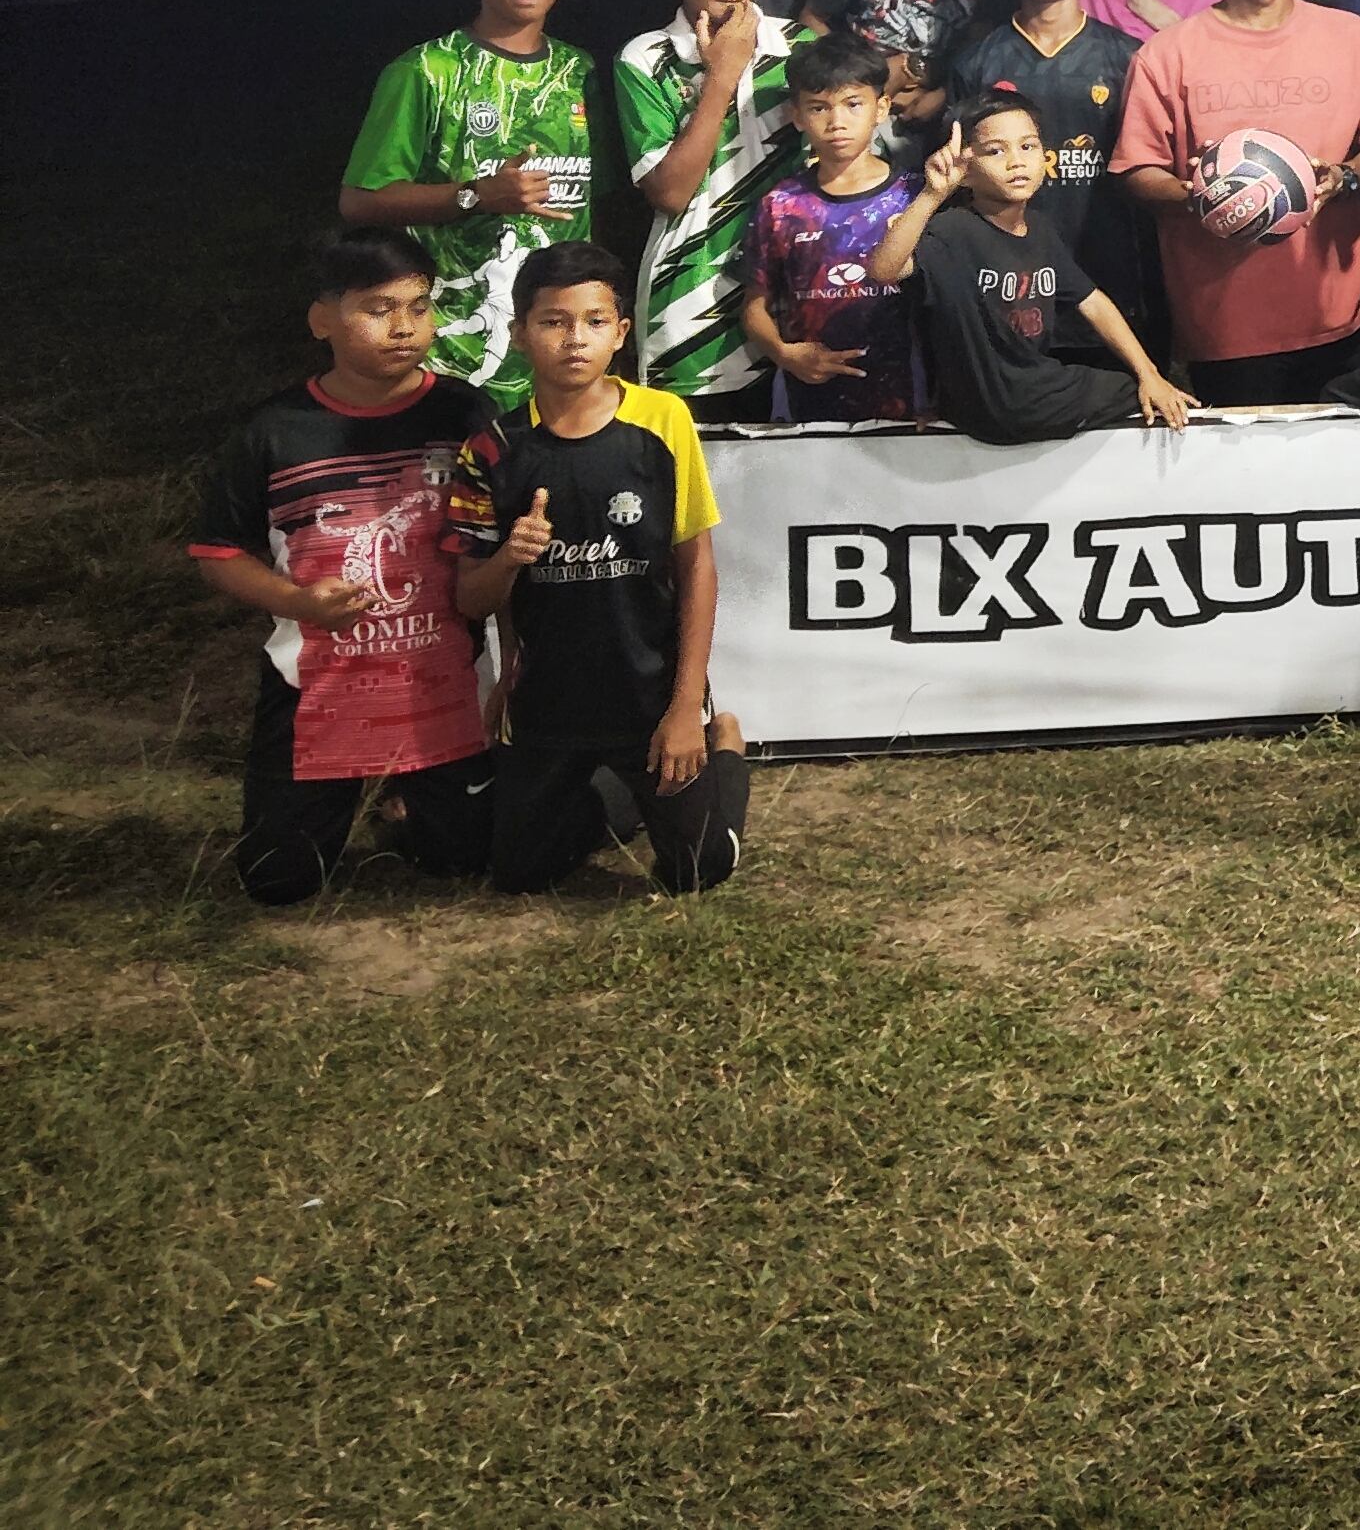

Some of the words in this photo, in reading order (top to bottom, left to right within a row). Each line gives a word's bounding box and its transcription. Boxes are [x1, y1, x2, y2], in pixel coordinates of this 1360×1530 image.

[1195, 76, 1331, 114] HANZO
[1059, 150, 1104, 165] REKA
[545, 534, 621, 565] Peteh
